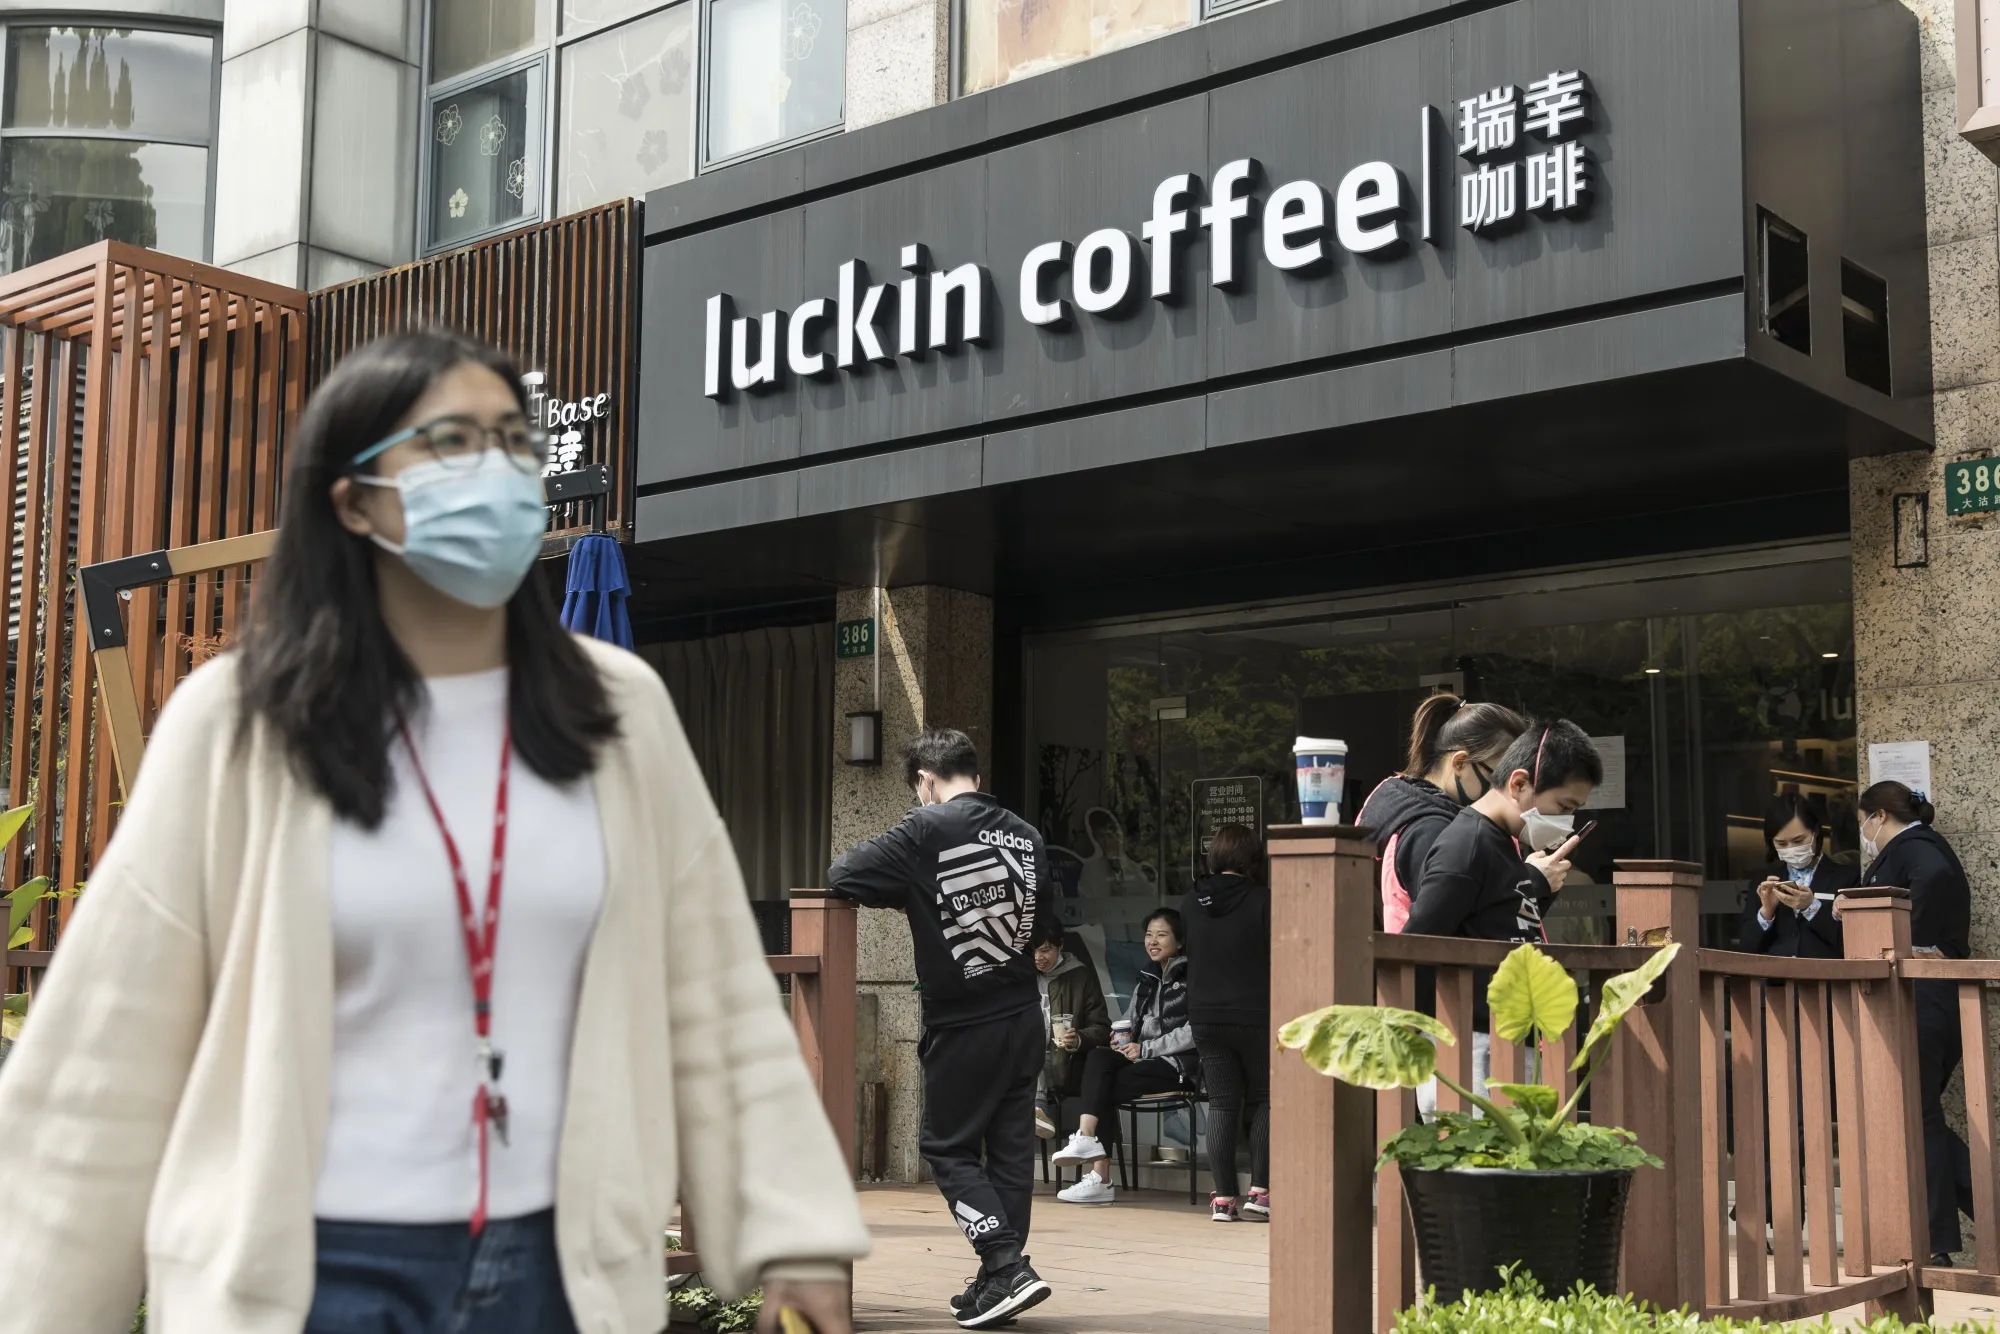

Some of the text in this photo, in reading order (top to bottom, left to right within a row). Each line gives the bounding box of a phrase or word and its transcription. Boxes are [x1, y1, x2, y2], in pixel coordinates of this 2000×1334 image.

[1458, 69, 1586, 156] 瑞幸
[1459, 141, 1587, 232] 咖啡
[704, 157, 1402, 399] luckin coffee
[842, 623, 869, 645] 386
[1206, 796, 1246, 805] STORE HOURS
[1209, 784, 1244, 797] 营业时间
[978, 829, 1034, 853] adidas
[1021, 853, 1037, 891] MOVE
